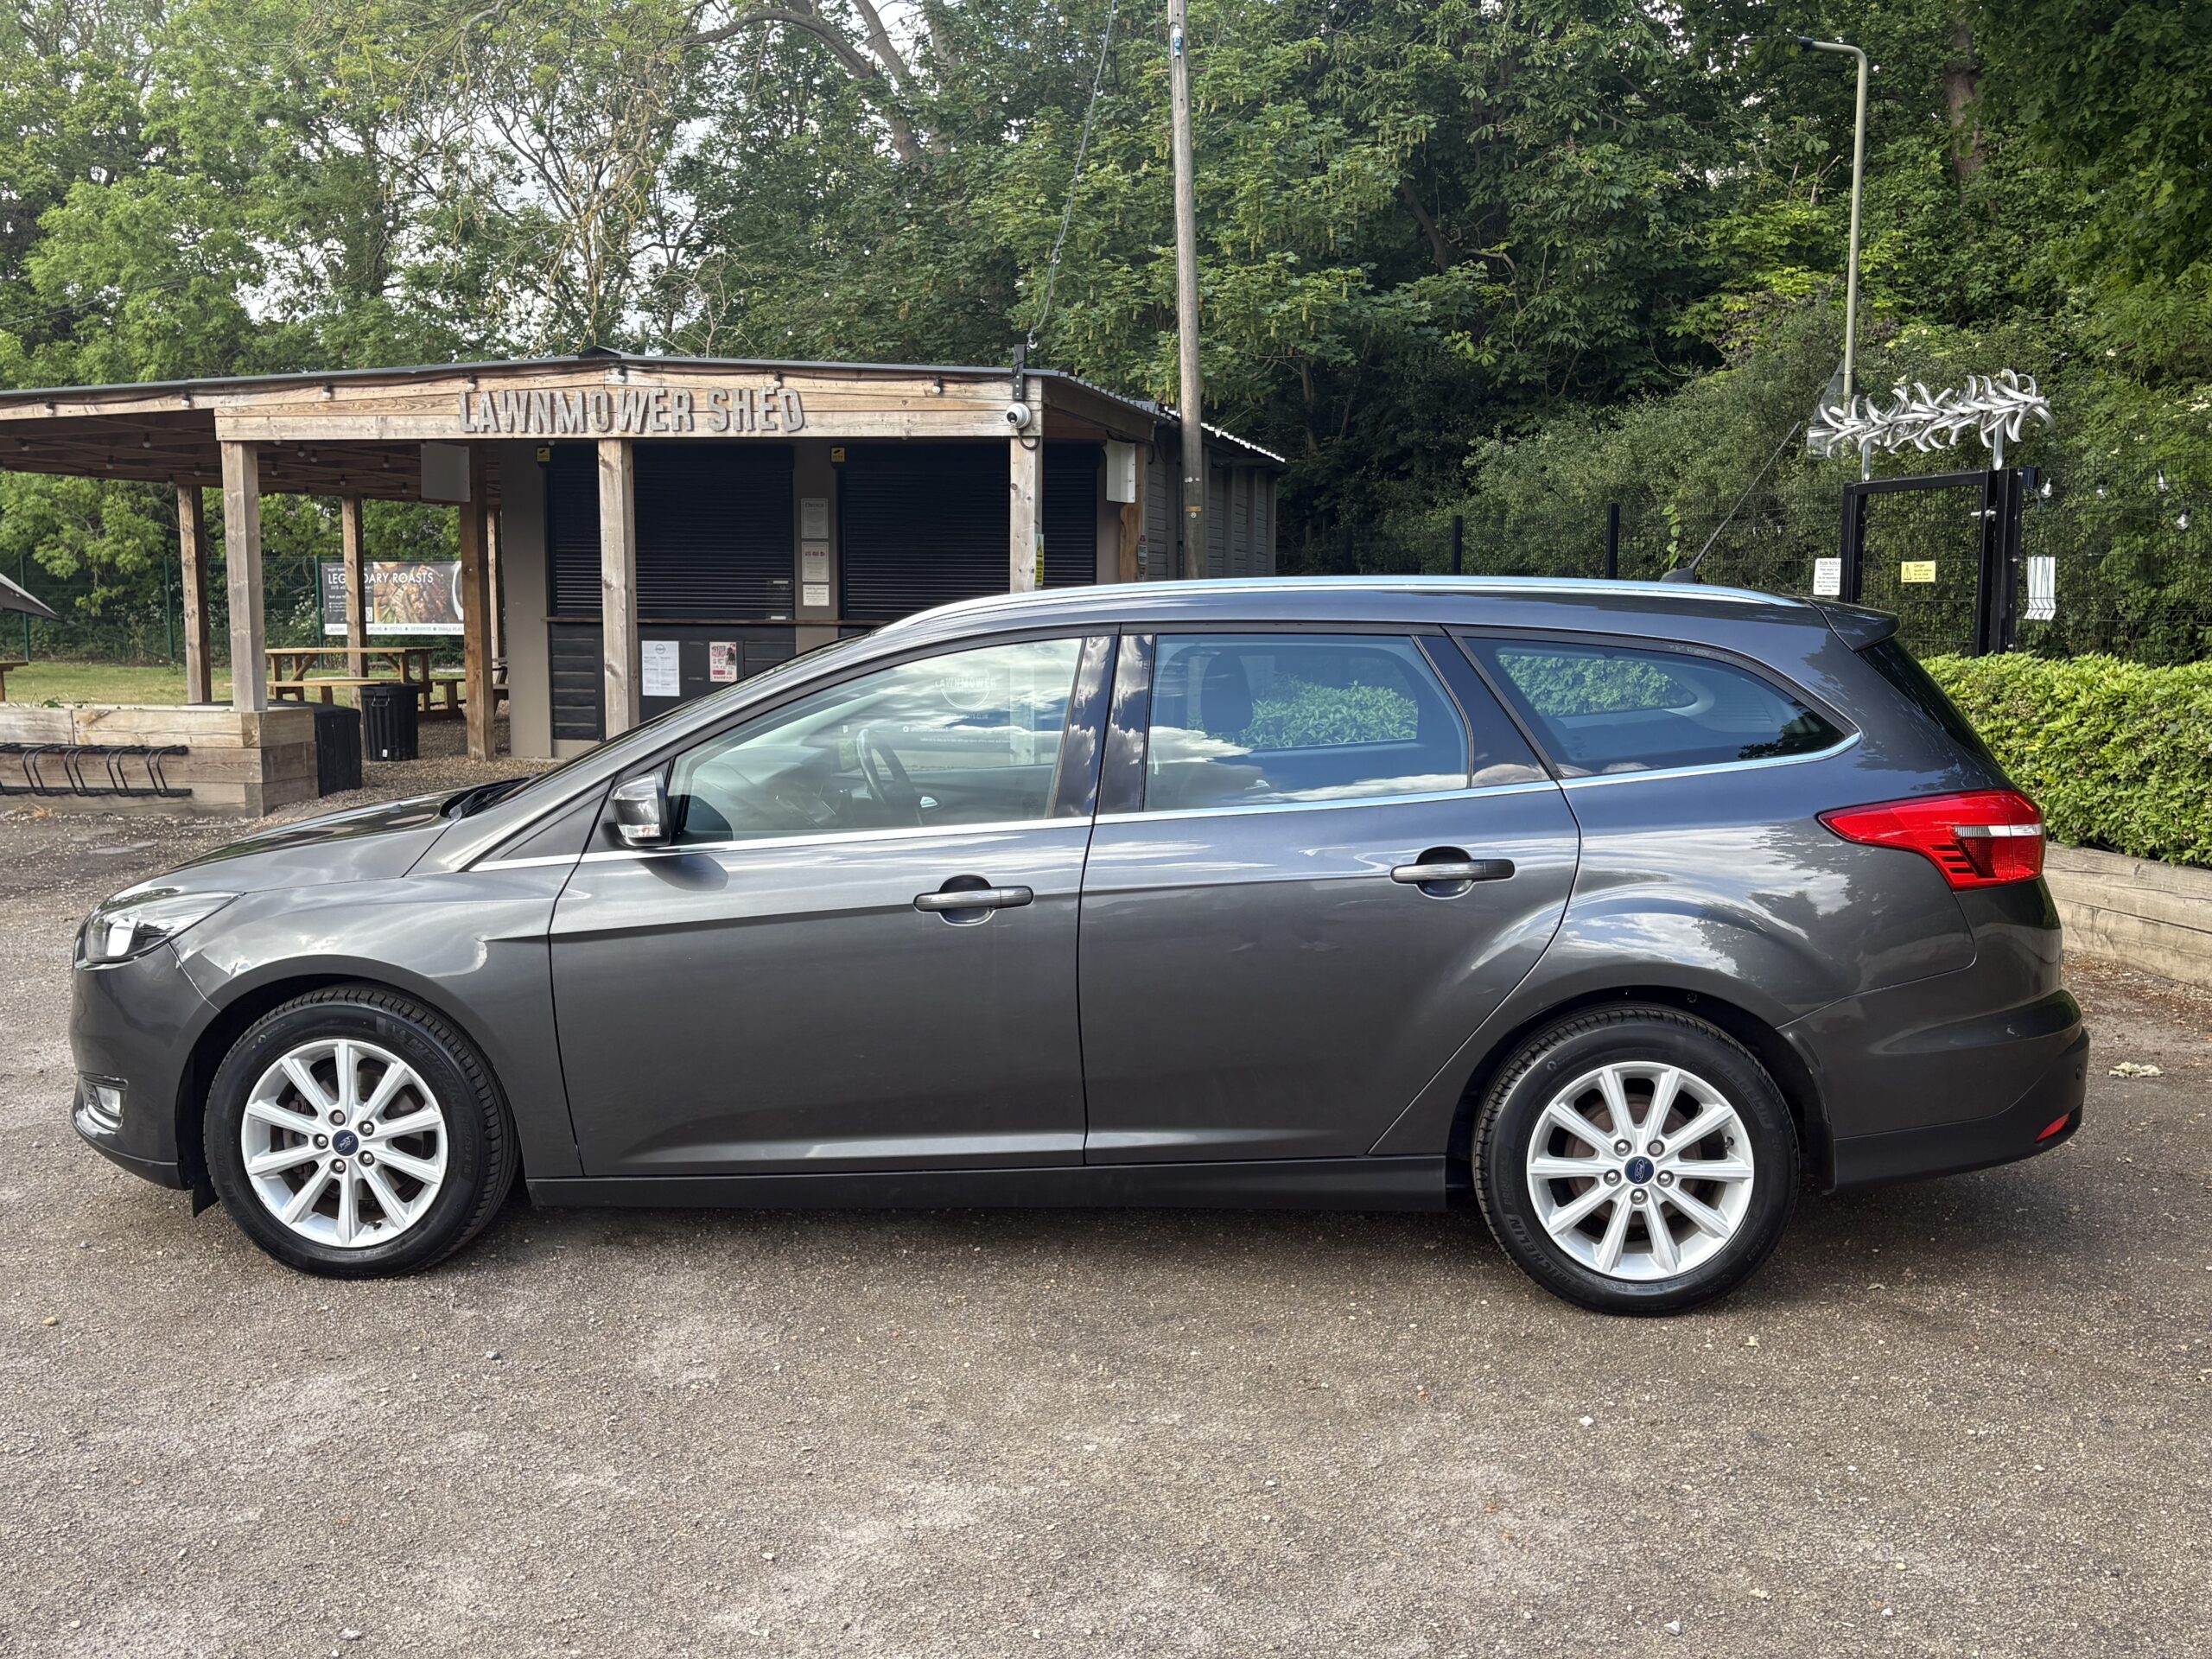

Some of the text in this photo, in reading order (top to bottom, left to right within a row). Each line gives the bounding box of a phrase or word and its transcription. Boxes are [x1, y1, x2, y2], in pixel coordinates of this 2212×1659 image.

[459, 387, 805, 432] LAWNMOWER SHED
[328, 573, 434, 584] LEGDARY ROASTS
[1509, 1217, 1571, 1286] MICHELIN
